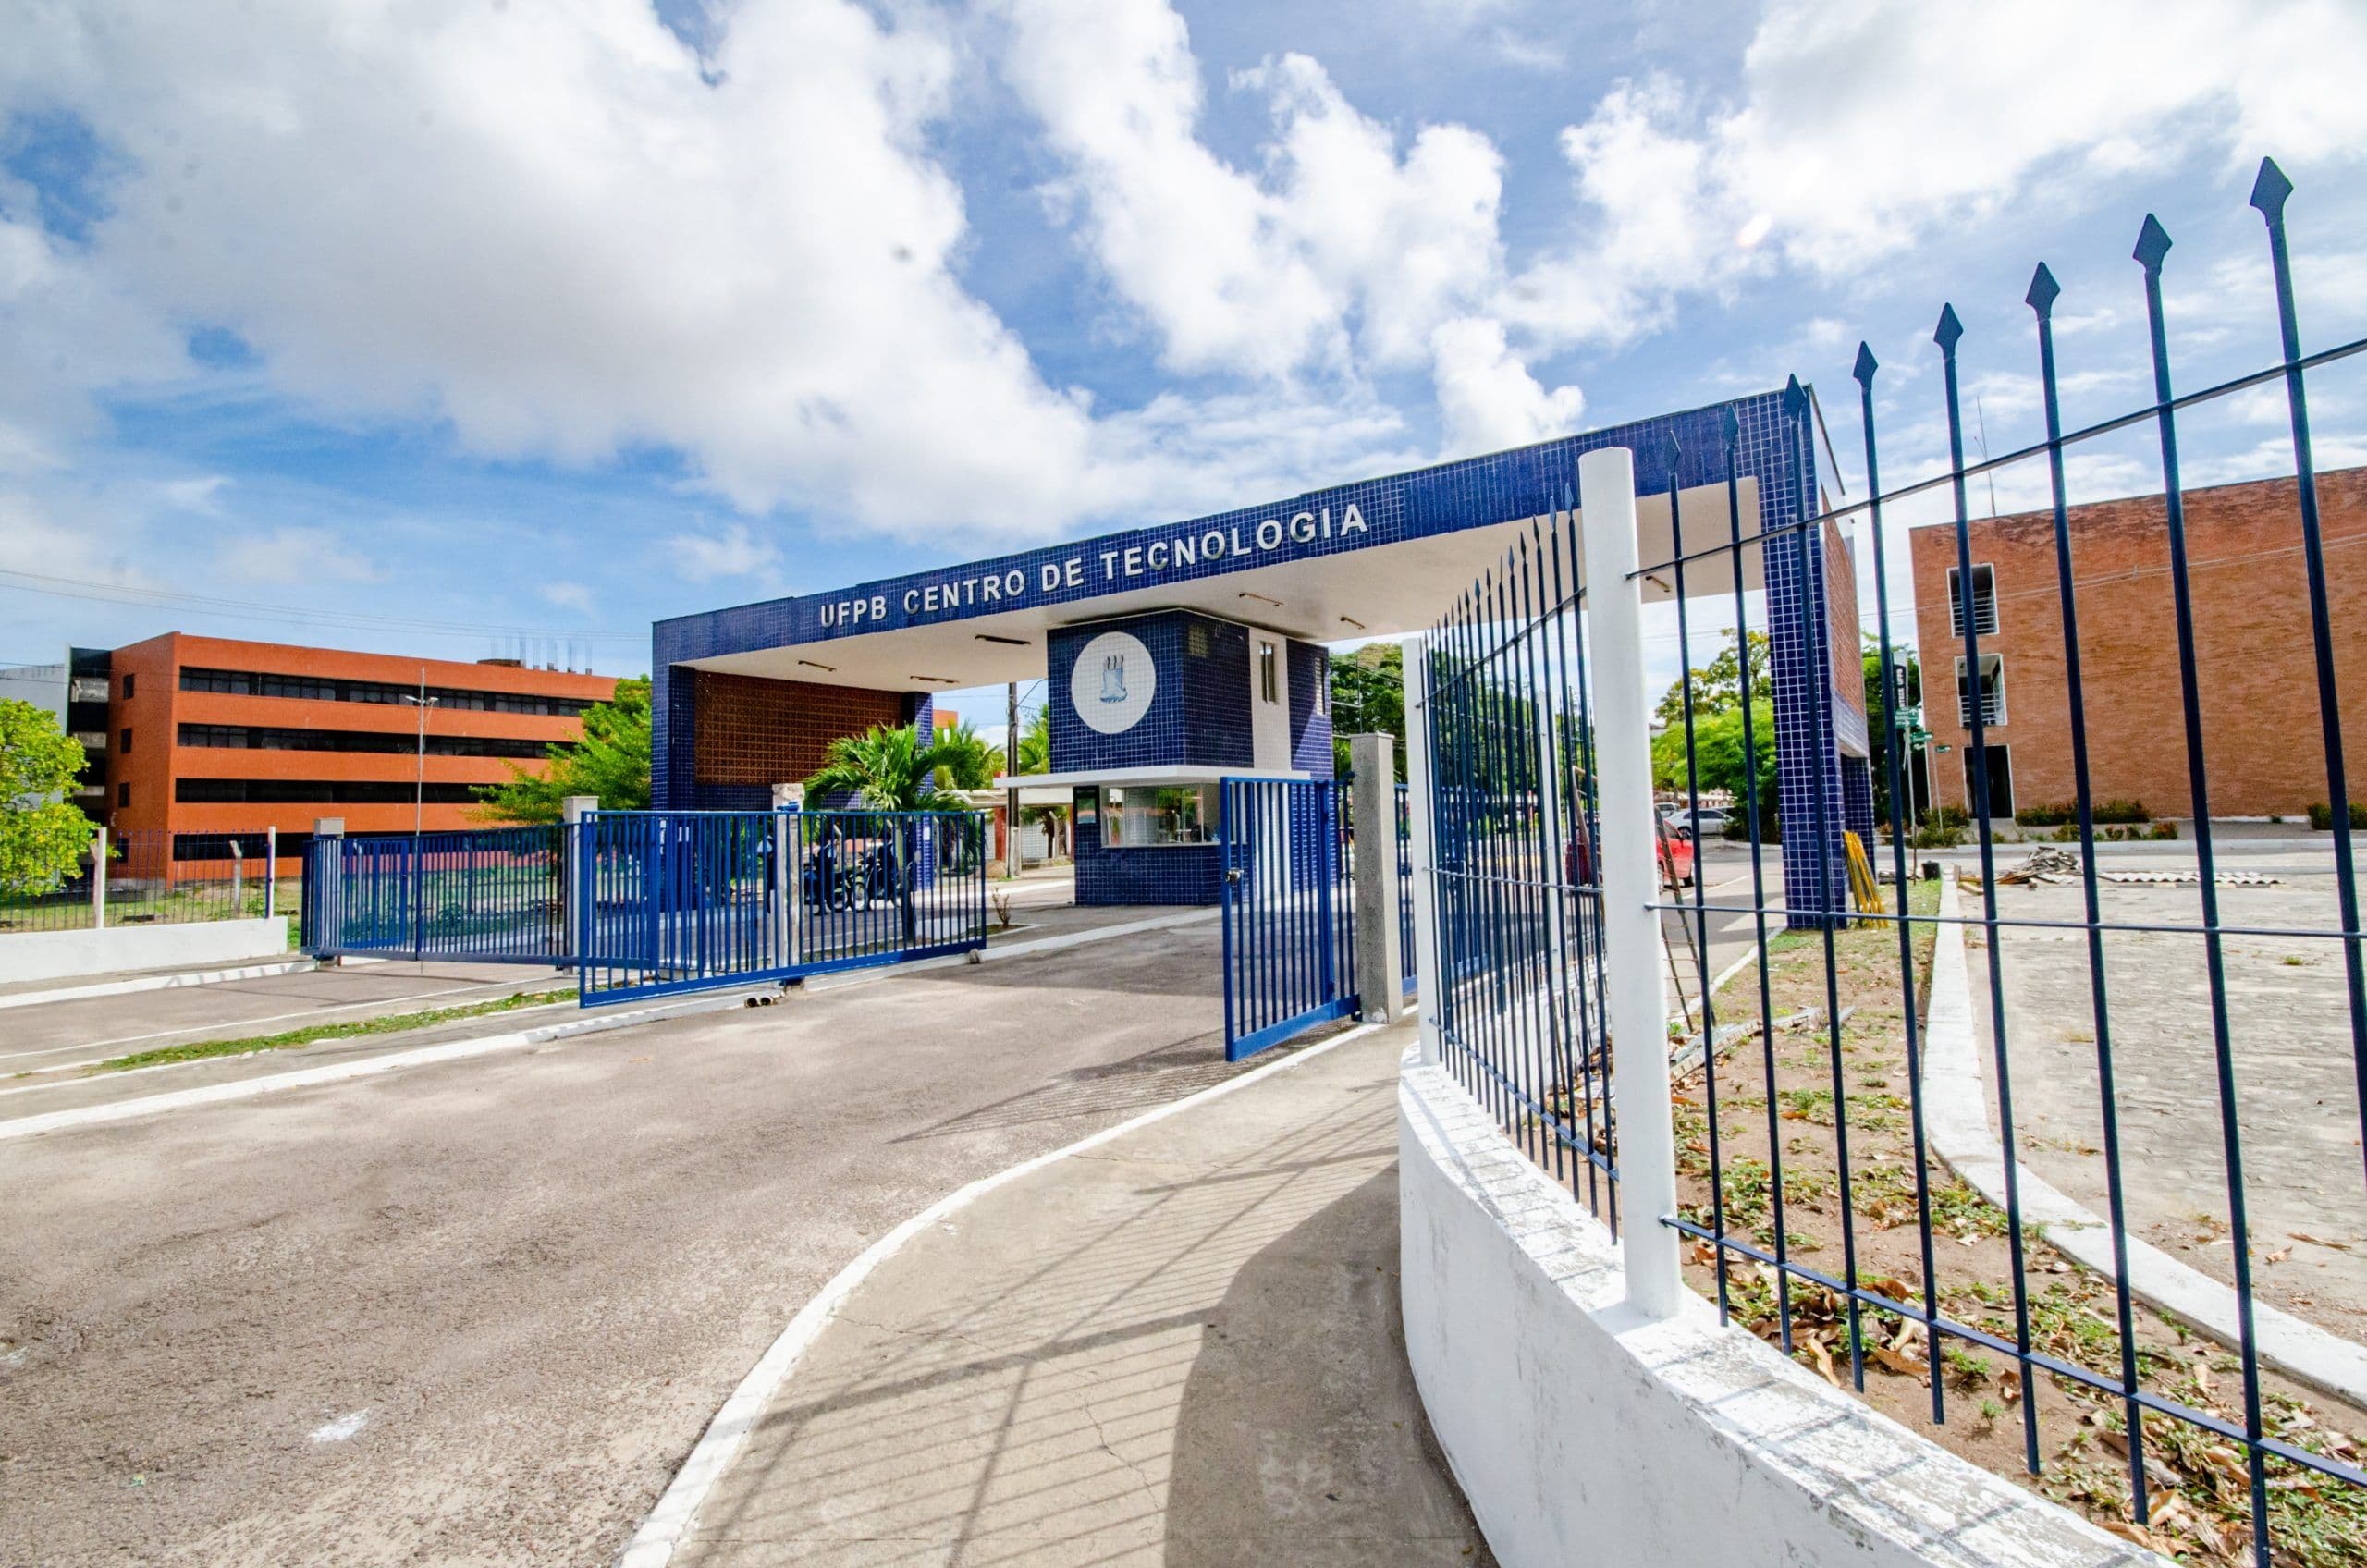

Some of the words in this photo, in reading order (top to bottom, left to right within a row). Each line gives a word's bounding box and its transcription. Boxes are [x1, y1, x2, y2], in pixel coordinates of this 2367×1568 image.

[821, 595, 887, 627] UFPB
[904, 570, 1025, 615] CENTRO
[1041, 557, 1085, 592] DE
[1100, 504, 1368, 580] TECNOLOGIA
